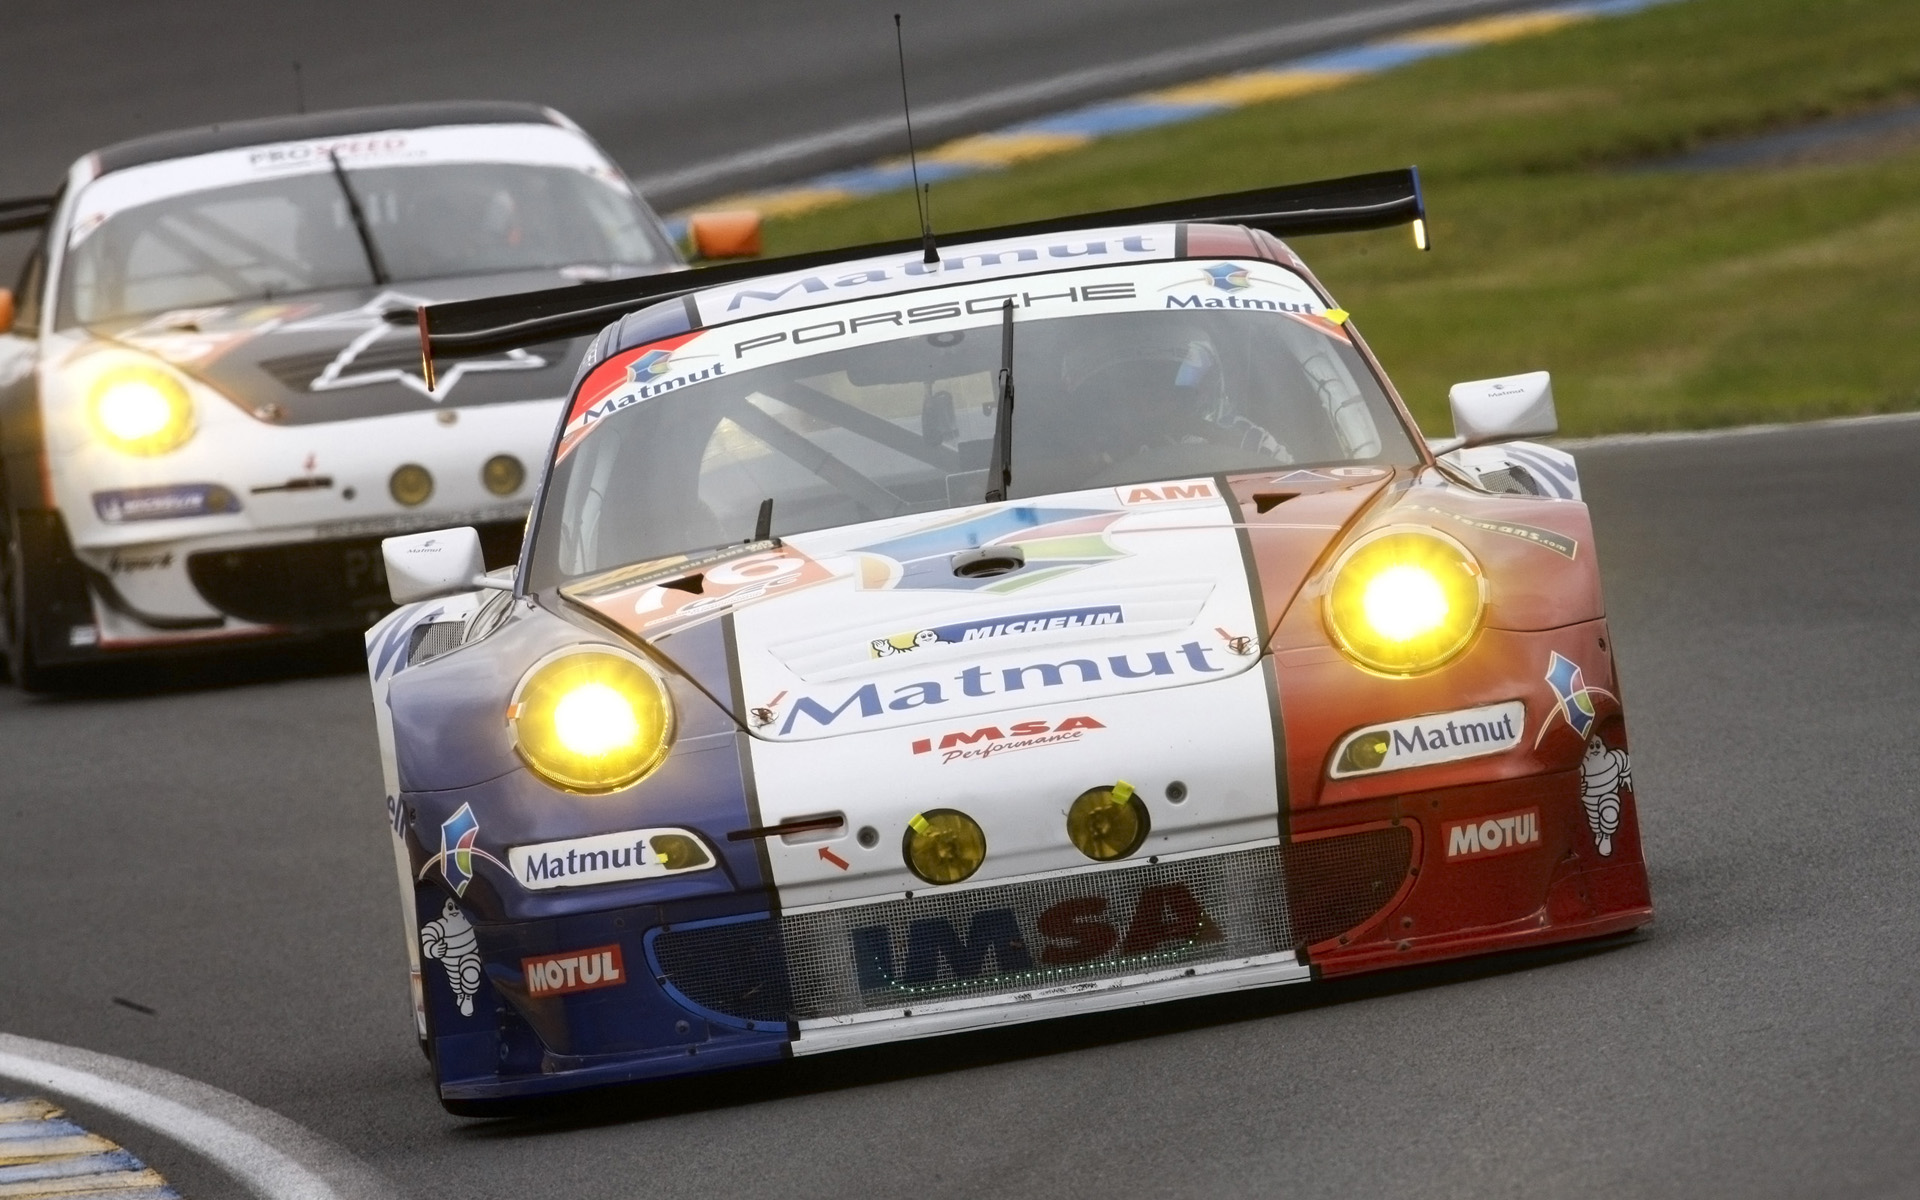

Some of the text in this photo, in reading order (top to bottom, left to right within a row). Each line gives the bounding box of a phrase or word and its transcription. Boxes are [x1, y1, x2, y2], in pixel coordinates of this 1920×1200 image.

[726, 235, 1156, 312] Matmut
[734, 282, 1137, 359] PORSCHE
[1165, 293, 1315, 315] Matmut
[583, 362, 726, 426] Matmut
[1487, 388, 1525, 398] Matmut
[1125, 483, 1215, 504] AM
[961, 610, 1121, 642] MICHELIN
[778, 640, 1225, 736] Matmut
[912, 715, 1108, 755] IMSA
[942, 729, 1084, 765] Performance
[1393, 713, 1516, 756] Matmut
[1448, 812, 1539, 857] MOTUL
[525, 840, 647, 883] Matmut
[851, 880, 1228, 990] IMSA
[527, 950, 621, 993] MOTUL
